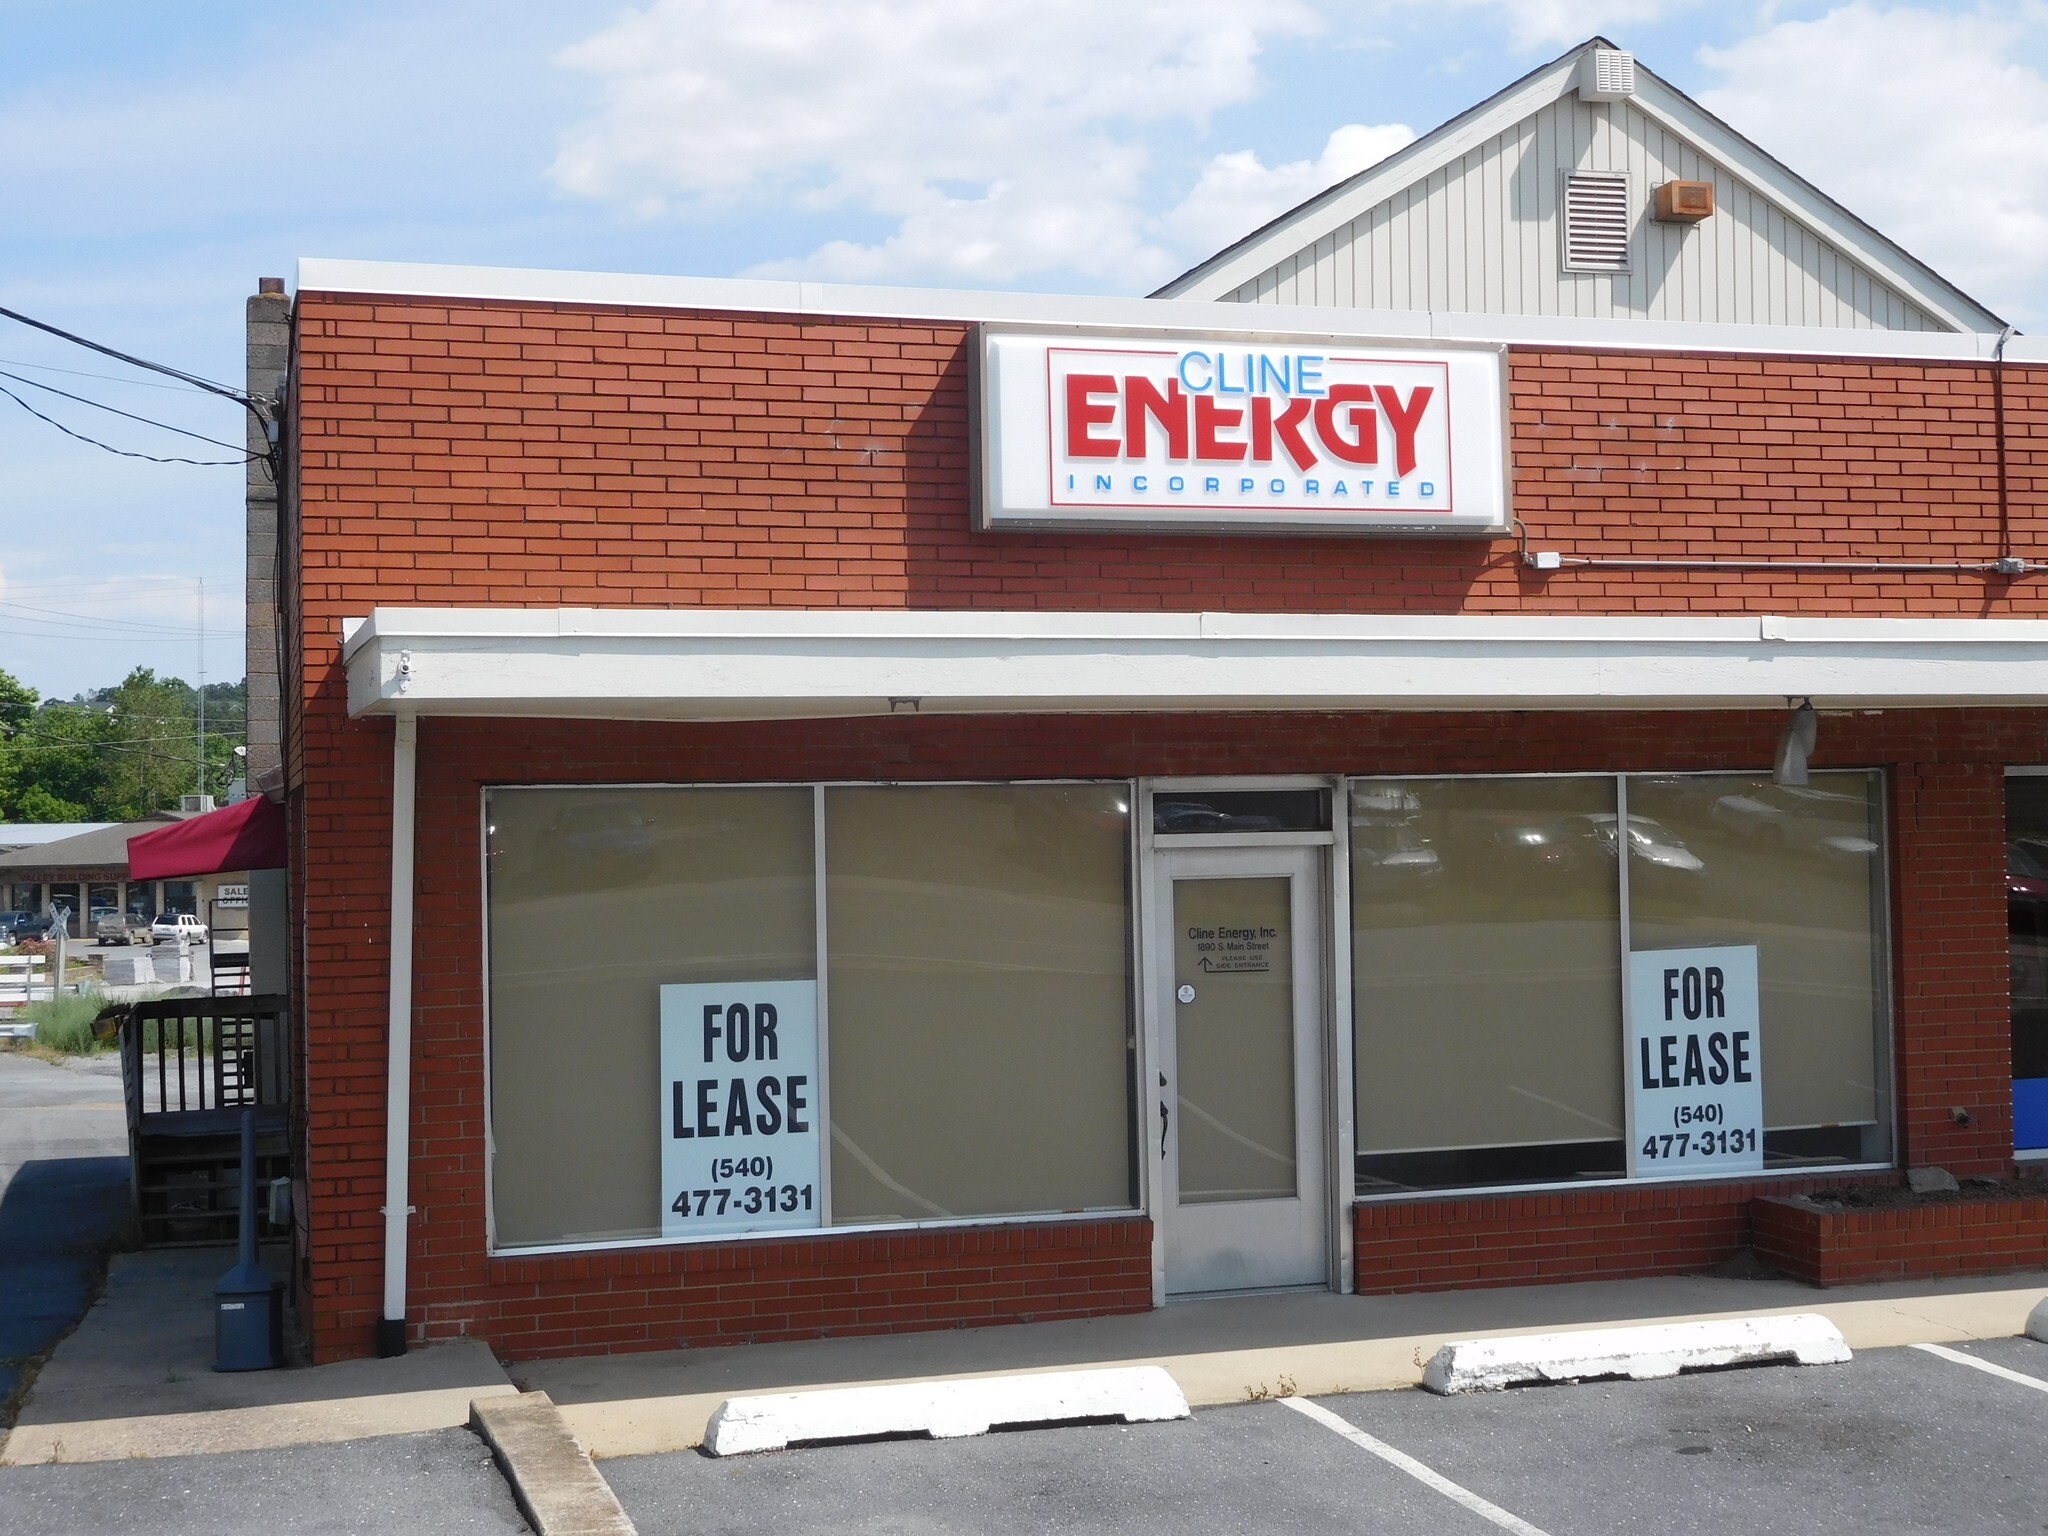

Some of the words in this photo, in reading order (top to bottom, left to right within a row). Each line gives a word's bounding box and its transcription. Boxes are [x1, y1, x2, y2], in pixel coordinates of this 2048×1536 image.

[1178, 351, 1328, 395] CLINE
[1066, 373, 1434, 478] ENERGY
[1069, 473, 1435, 496] INCORPORATED
[20, 873, 55, 882] VALLEY
[57, 872, 101, 881] BUILDING
[1188, 927, 1215, 939] Cline
[1219, 926, 1257, 941] Energy,
[1260, 926, 1277, 938] Inc.
[1197, 942, 1216, 952] 1890
[1227, 941, 1244, 951] Main
[1246, 941, 1269, 951] Street
[1663, 966, 1725, 1021] FOR
[703, 1002, 778, 1062] FOR
[1640, 1031, 1752, 1090] LEASE
[673, 1075, 809, 1139] LEASE
[1673, 1103, 1724, 1128] (540)
[1642, 1128, 1756, 1159] 477-3131
[711, 1156, 773, 1182] (540)
[671, 1184, 812, 1218] 477-3131
